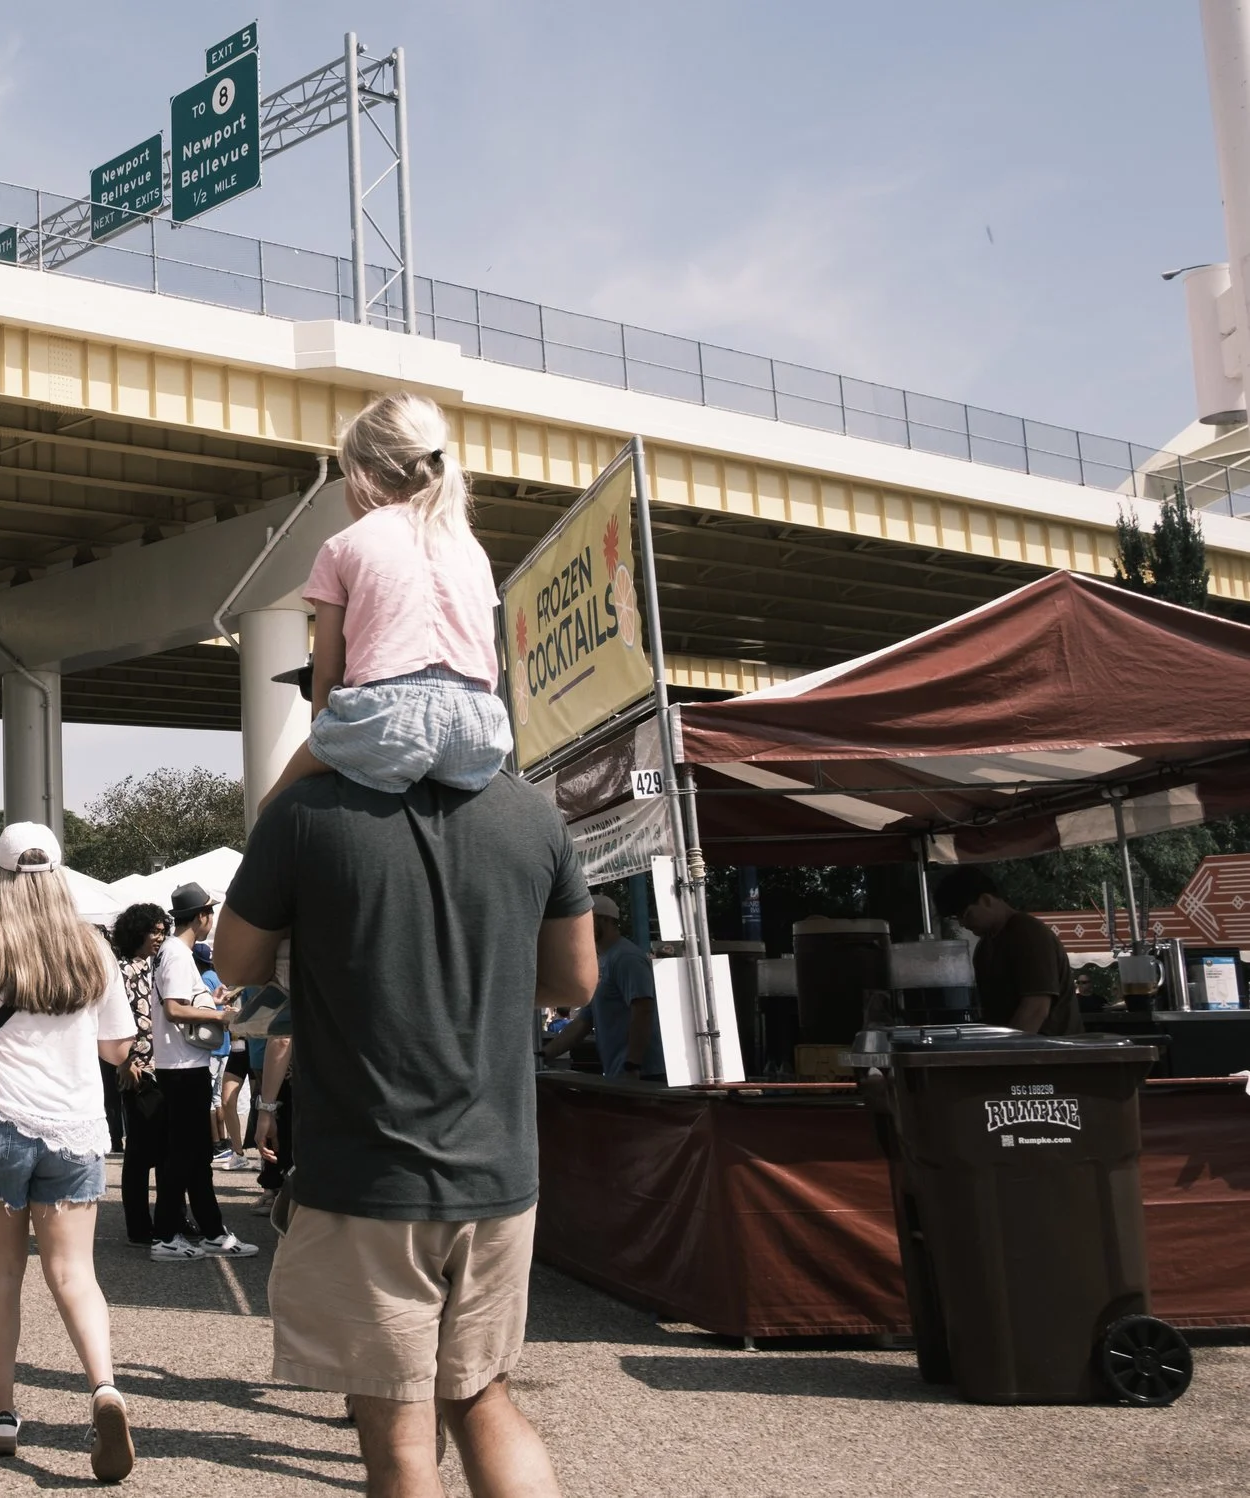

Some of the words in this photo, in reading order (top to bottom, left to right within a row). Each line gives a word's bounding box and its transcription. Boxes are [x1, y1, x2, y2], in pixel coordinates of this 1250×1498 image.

[211, 42, 234, 65] EXIT
[242, 30, 251, 48] 5
[191, 101, 206, 119] TO
[218, 86, 229, 107] 8
[182, 113, 247, 161] Newport
[102, 148, 150, 185] Newport
[181, 143, 249, 188] Bellevue
[101, 171, 152, 206] Bellevue
[214, 174, 238, 195] MILE
[93, 211, 116, 232] NEXT
[121, 202, 130, 219] 2
[135, 187, 160, 209] EXITS
[536, 546, 592, 634] FROZEN
[527, 582, 619, 697] COCKTAILS
[636, 771, 663, 796] 429
[984, 1098, 1082, 1132] RUMPKE
[1018, 1136, 1072, 1146] Rumpke.com
